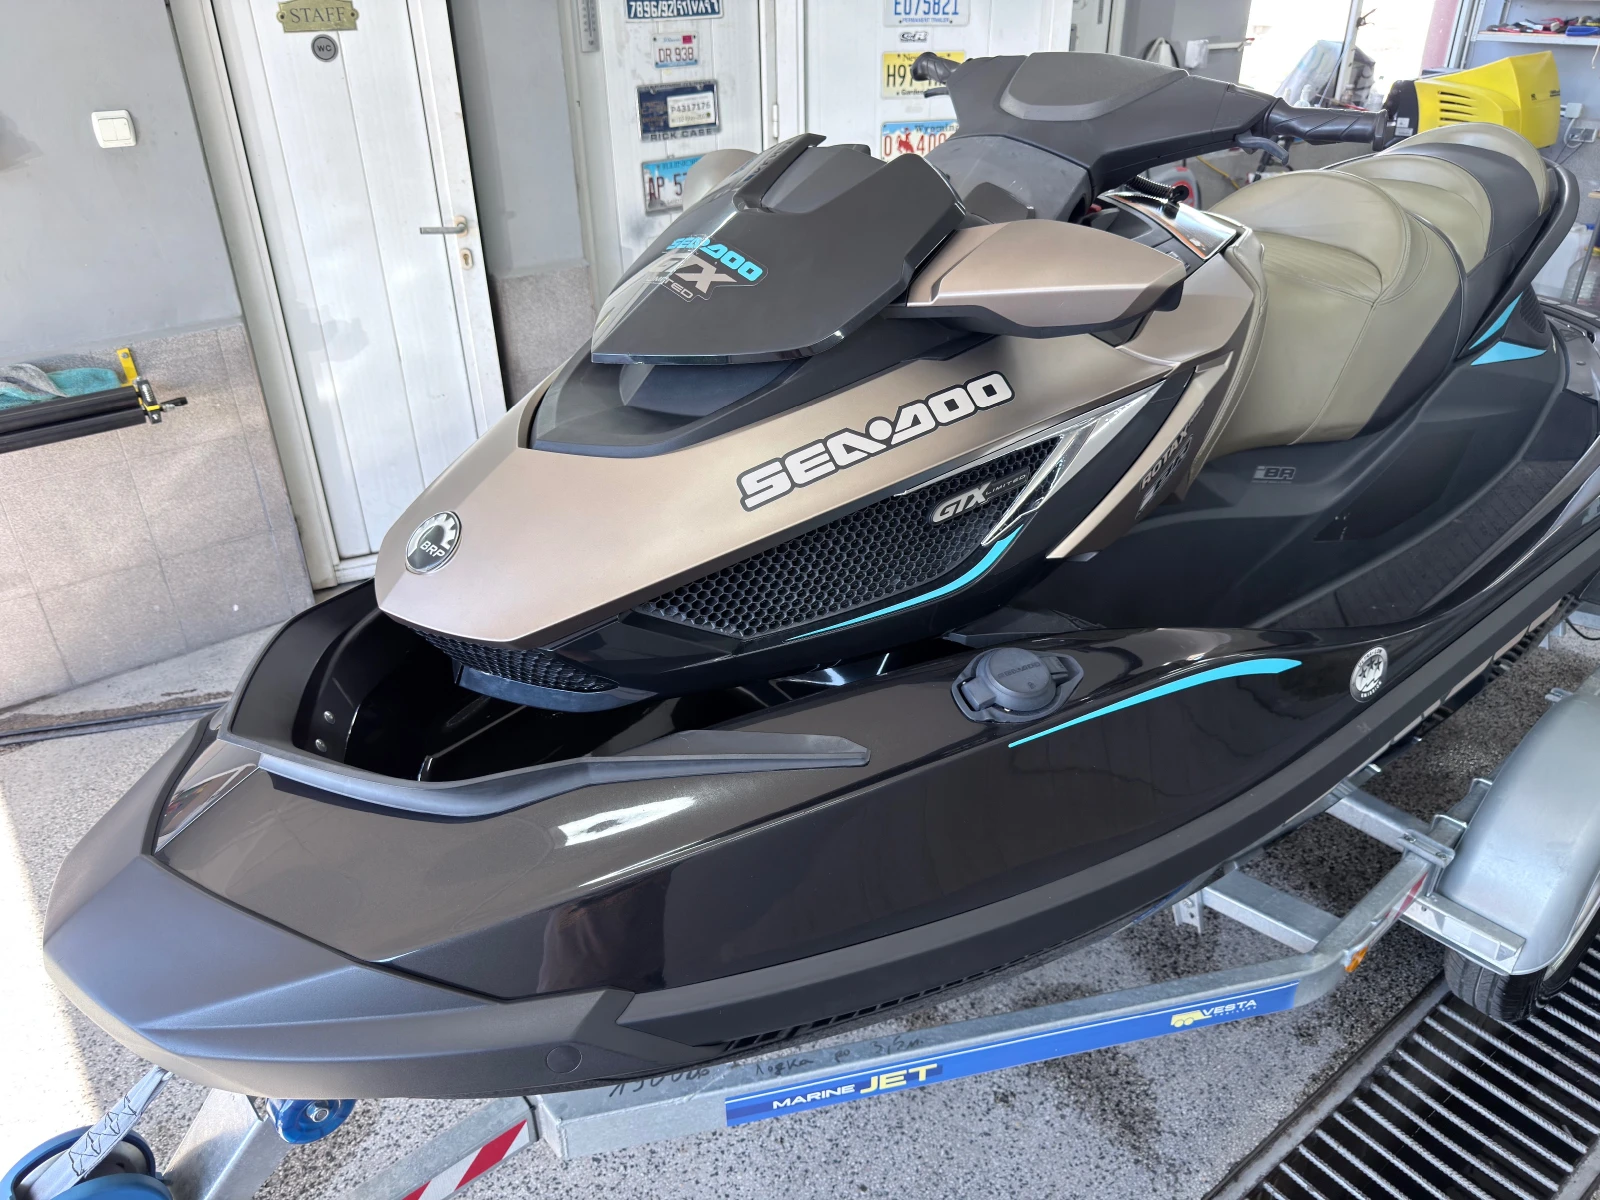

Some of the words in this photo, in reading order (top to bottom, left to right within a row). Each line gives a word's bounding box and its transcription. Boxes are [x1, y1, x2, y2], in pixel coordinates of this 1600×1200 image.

[289, 7, 345, 23] STAFF
[658, 48, 672, 62] DR
[675, 47, 694, 61] 938
[651, 132, 677, 141] RICK
[682, 129, 713, 138] CASE
[648, 176, 665, 201] AP
[673, 172, 688, 196] 5
[1141, 426, 1189, 490] ROTAX
[932, 482, 991, 523] GTX
[985, 474, 1026, 495] LIMITED
[420, 540, 446, 558] BRP
[1202, 999, 1257, 1016] VESTA
[772, 1084, 855, 1110] MARINE
[860, 1063, 938, 1094] JET
